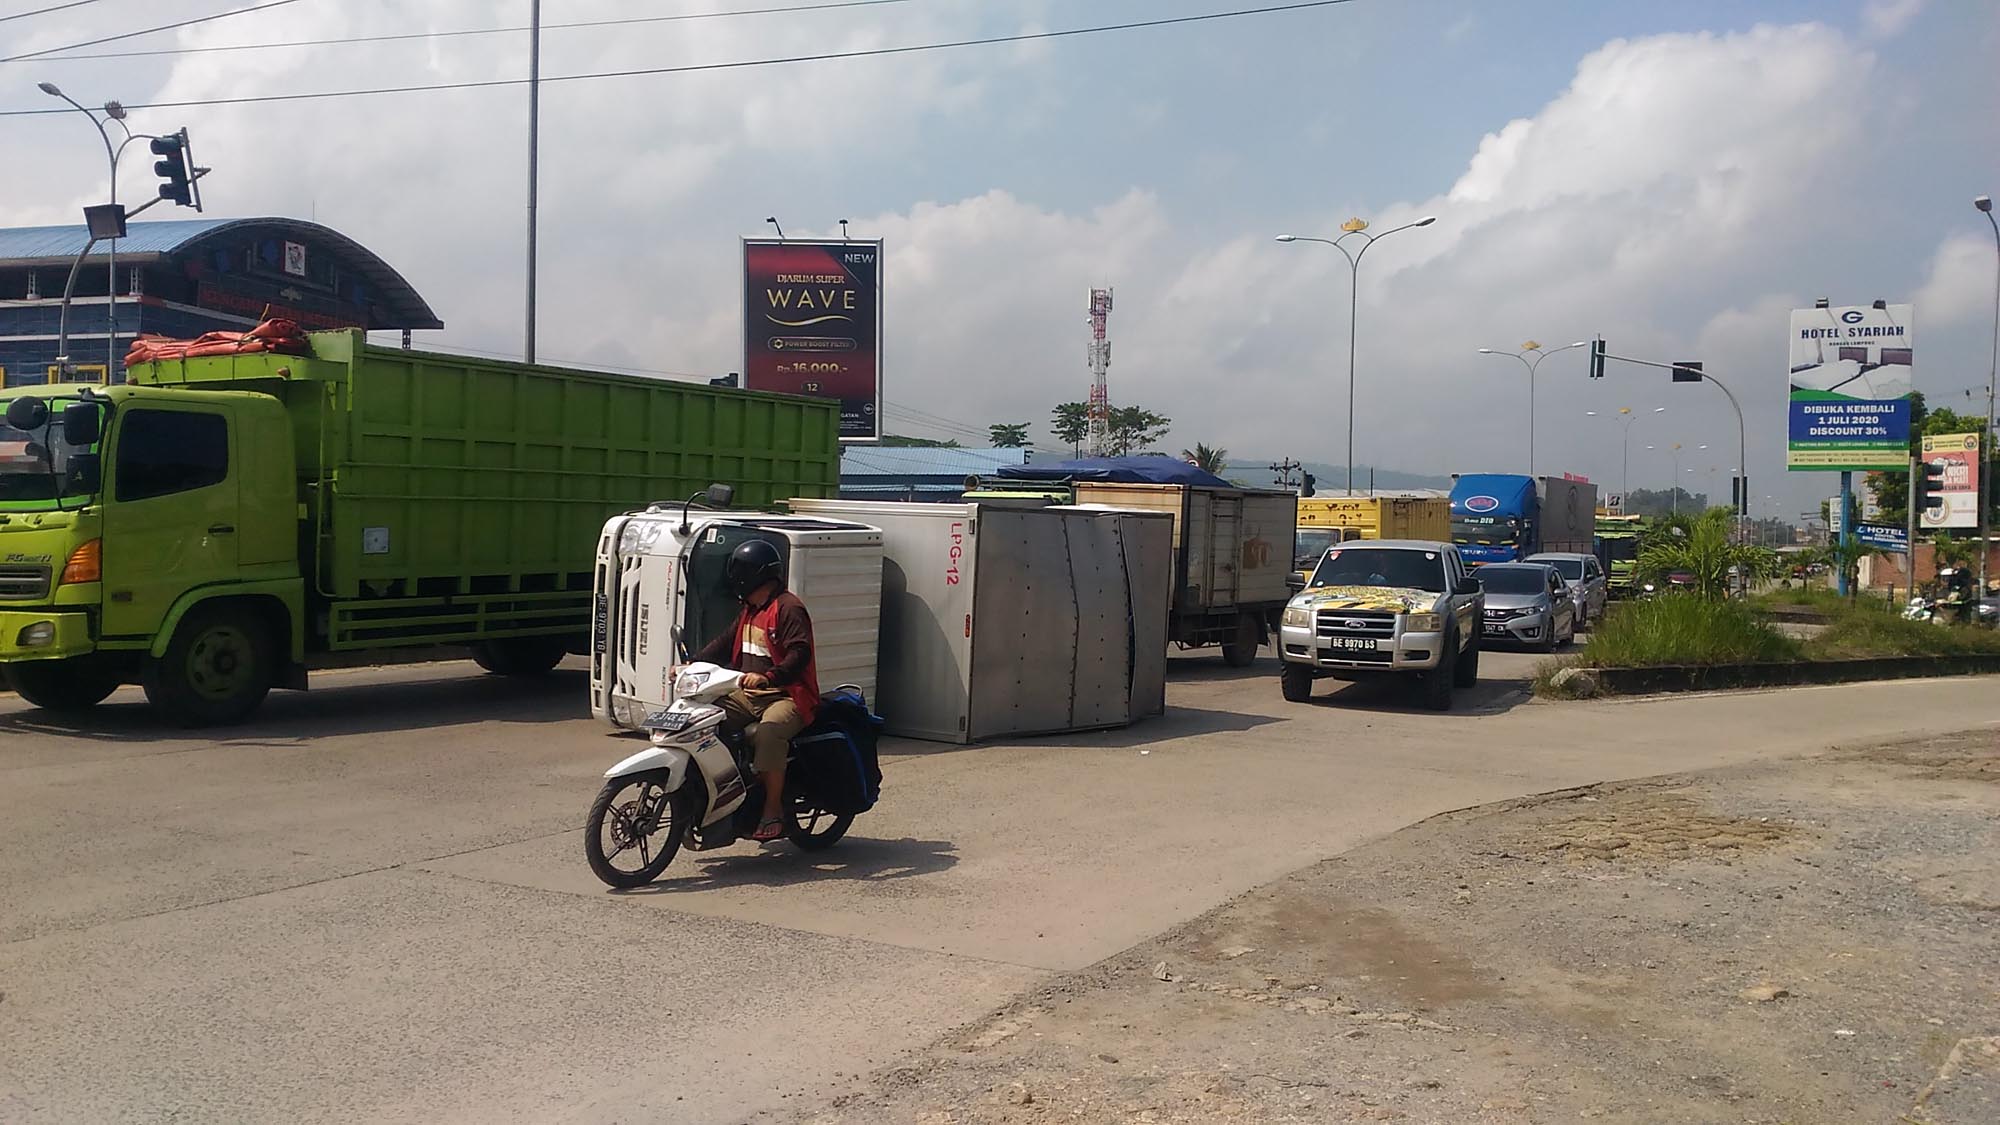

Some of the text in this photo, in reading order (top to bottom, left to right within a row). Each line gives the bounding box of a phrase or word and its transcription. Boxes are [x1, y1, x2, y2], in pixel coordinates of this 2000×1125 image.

[844, 253, 874, 263] NEW
[777, 274, 845, 283] DJARUM SUPER
[766, 288, 855, 309] WAVE
[1801, 326, 1904, 339] HOTEL SYARIAH
[807, 383, 818, 392] 12
[1804, 405, 1895, 414] DIBUKA KEMBALI
[1818, 416, 1879, 424] 1 JULI 2020
[1809, 427, 1887, 435] DISCOUNT 30%
[1867, 526, 1905, 536] HOTEL
[946, 522, 962, 585] LPG-12
[597, 612, 608, 634] 9703
[639, 603, 650, 656] ISUZU
[1332, 638, 1344, 647] BE
[1344, 639, 1363, 648] 9970
